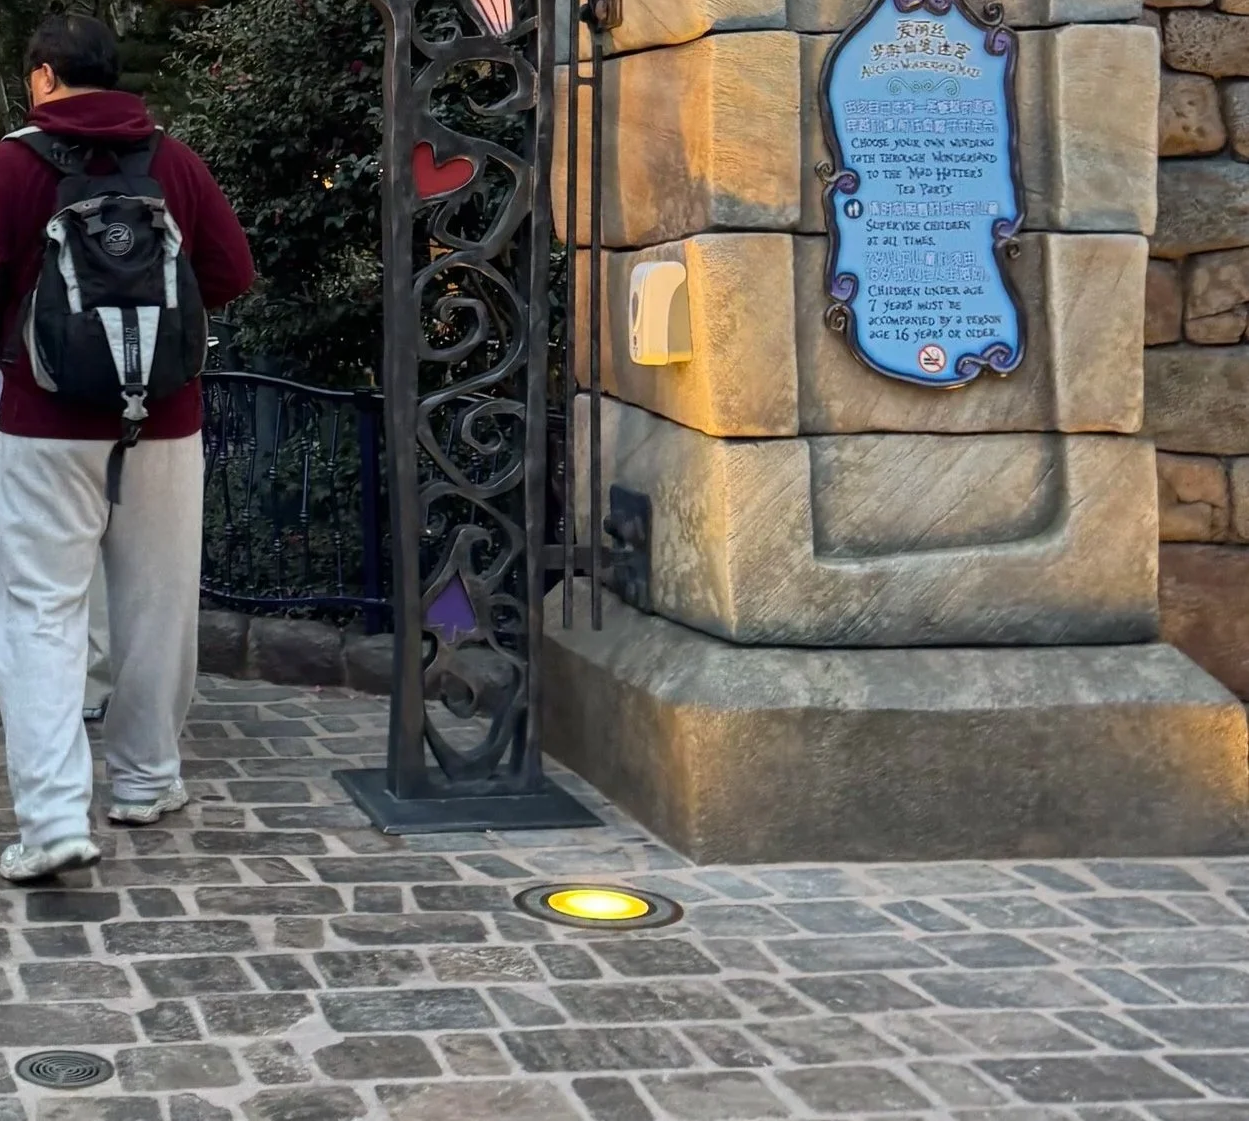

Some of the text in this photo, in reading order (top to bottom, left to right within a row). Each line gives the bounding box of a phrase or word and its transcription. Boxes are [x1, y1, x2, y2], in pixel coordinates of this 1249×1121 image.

[897, 19, 946, 41] 爱丽丝
[870, 39, 971, 61] 梦游仙境迷宫
[868, 299, 877, 312] 7
[894, 328, 910, 342] 16
